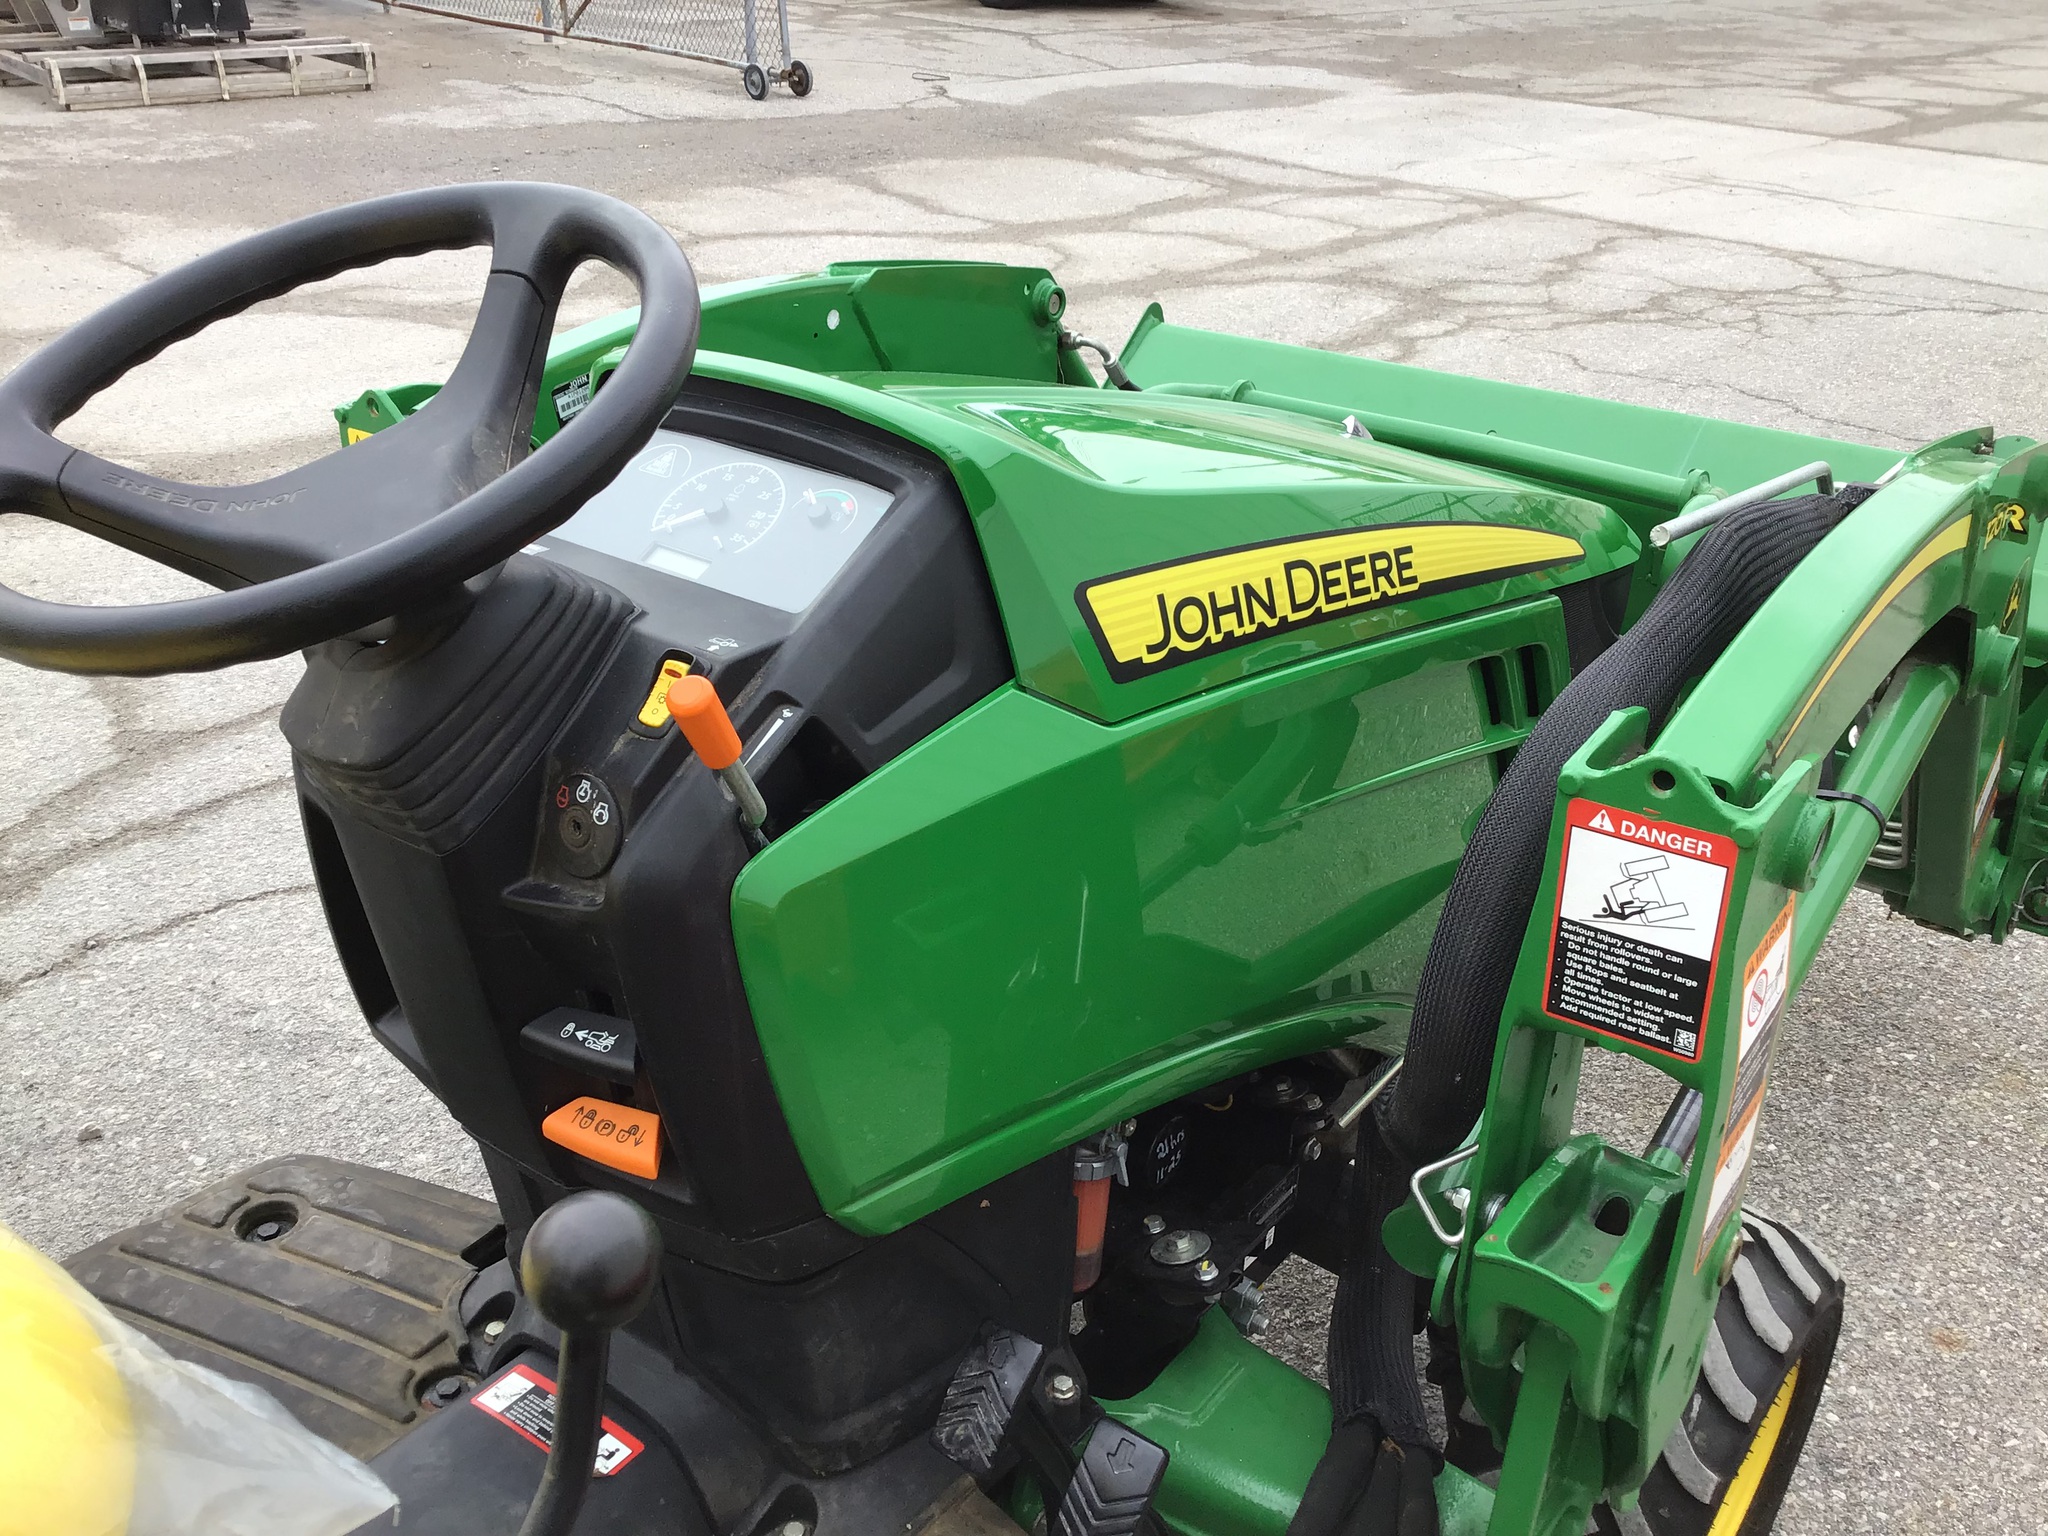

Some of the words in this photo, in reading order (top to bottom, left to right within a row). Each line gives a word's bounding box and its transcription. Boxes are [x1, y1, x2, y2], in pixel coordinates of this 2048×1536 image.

[569, 375, 588, 389] JOHN
[102, 471, 218, 513] DEERE
[722, 473, 734, 481] 15
[745, 475, 759, 484] 20
[757, 491, 772, 500] 25
[226, 488, 307, 512] JOHN
[752, 510, 766, 519] 30
[1145, 577, 1279, 658] JOHN
[1284, 545, 1420, 616] DEERE
[1621, 820, 1712, 858] DANGER
[1560, 932, 1586, 943] result
[1588, 939, 1608, 951] from
[1611, 947, 1653, 964] rollovers.
[1562, 921, 1595, 937] Serious
[1597, 932, 1622, 946] injury
[1637, 945, 1663, 958] death
[1666, 954, 1683, 964] can
[1566, 959, 1583, 970] Use
[1585, 965, 1608, 978] Rops
[1610, 974, 1628, 984] and
[1630, 980, 1667, 996] seatbelt
[1669, 992, 1679, 1000] at
[1567, 951, 1597, 965] square
[1599, 960, 1626, 975] bales.
[1568, 941, 1580, 951] Do
[1583, 947, 1597, 956] not
[1600, 951, 1630, 966] handle
[1632, 963, 1660, 976] round
[1674, 974, 1698, 987] large
[1577, 971, 1604, 985] times.
[1561, 994, 1625, 1019] recommended
[1627, 1016, 1661, 1032] setting.
[1562, 984, 1586, 997] Move
[1589, 994, 1620, 1008] wheels
[1622, 1004, 1631, 1012] to
[1634, 1009, 1664, 1023] widest
[1563, 976, 1599, 993] Operate
[1601, 988, 1632, 1003] tractor
[1645, 1002, 1662, 1013] low
[1664, 1009, 1695, 1023] speed.
[1560, 1002, 1578, 1012] Add
[1580, 1009, 1616, 1025] required
[1618, 1022, 1637, 1032] rear
[1639, 1027, 1672, 1044] ballast.
